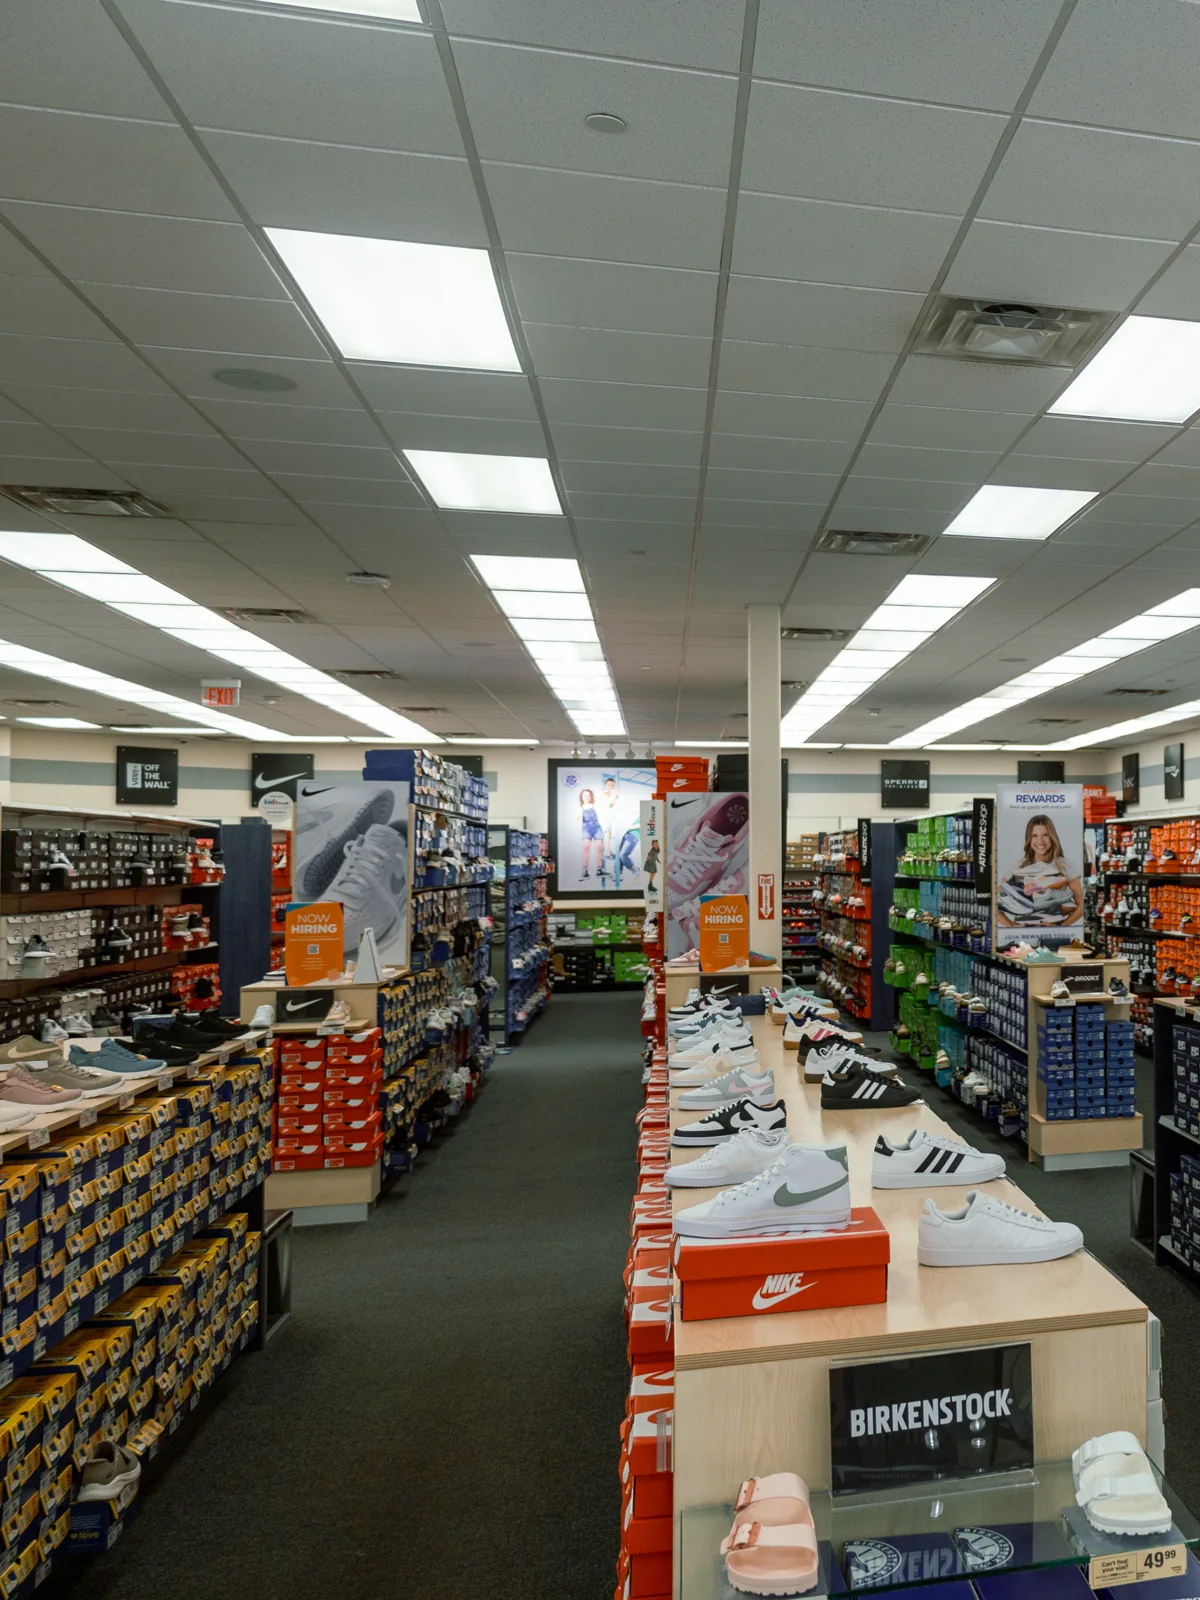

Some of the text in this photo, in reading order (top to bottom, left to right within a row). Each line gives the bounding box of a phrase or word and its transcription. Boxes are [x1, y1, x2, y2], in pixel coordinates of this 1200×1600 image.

[208, 687, 235, 706] EXIT
[1016, 794, 1066, 803] REWARDS
[711, 905, 738, 914] NOW
[297, 914, 330, 923] NOW
[705, 915, 744, 925] HIRING
[291, 924, 337, 934] HIRING
[1074, 974, 1100, 982] BROOKS
[761, 1272, 804, 1295] NIKE
[851, 1388, 1011, 1438] BIRKENSTOCK
[79, 1531, 99, 1539] love
[1101, 1558, 1128, 1568] Can't find
